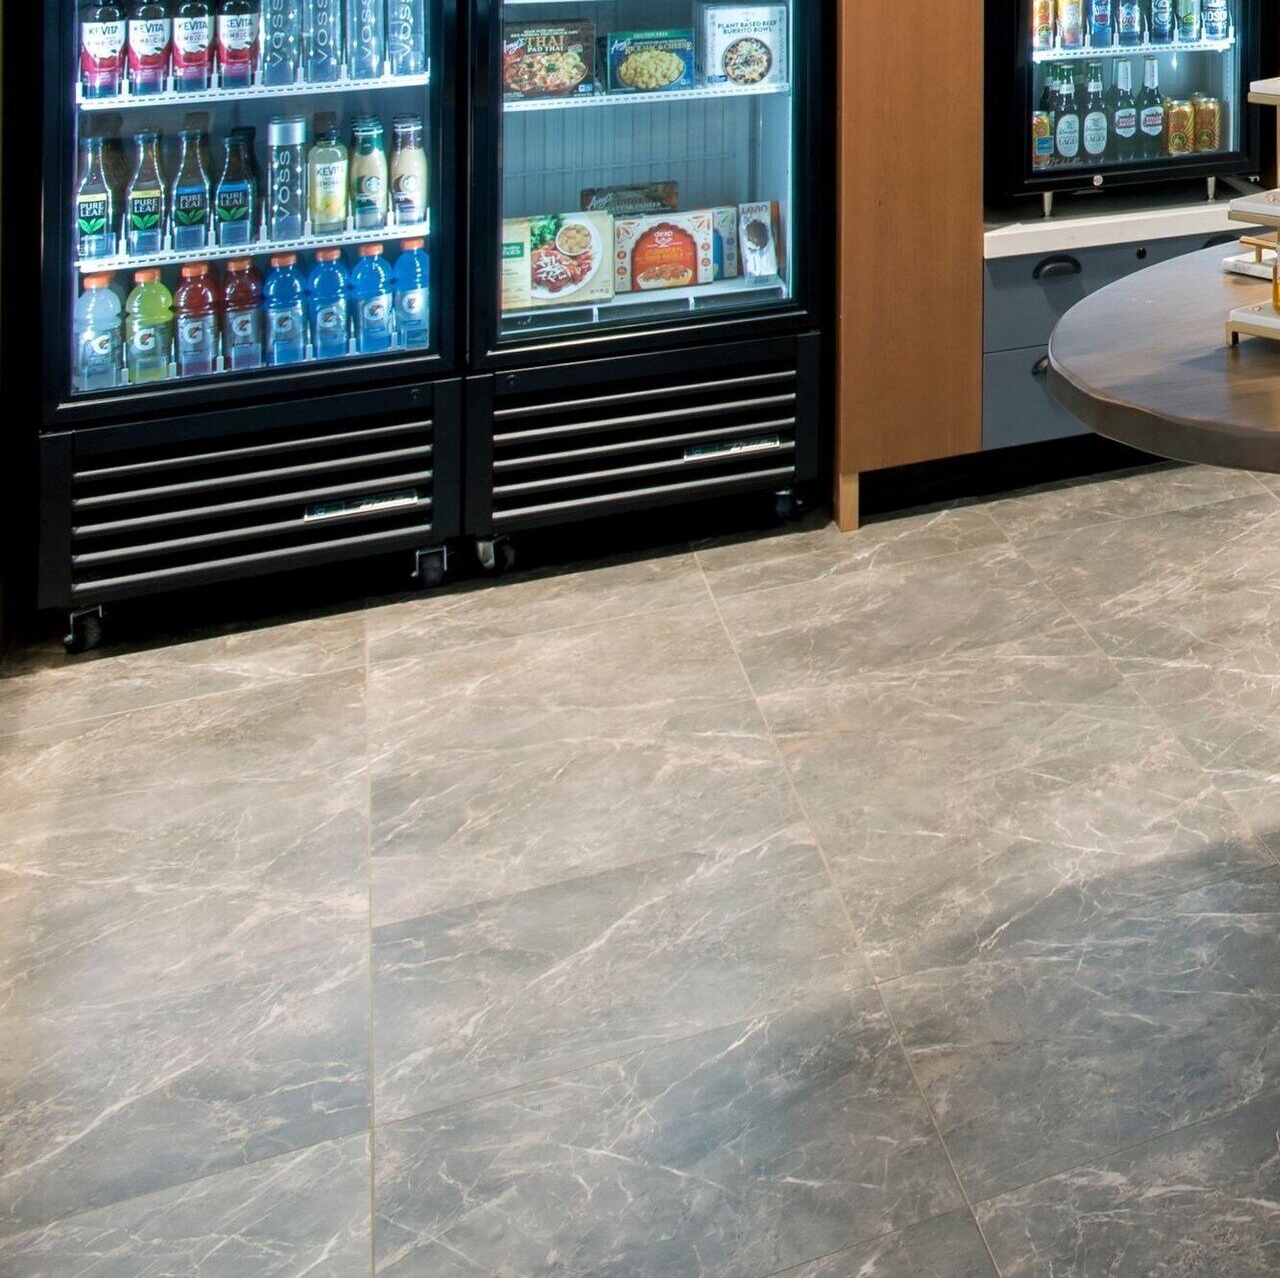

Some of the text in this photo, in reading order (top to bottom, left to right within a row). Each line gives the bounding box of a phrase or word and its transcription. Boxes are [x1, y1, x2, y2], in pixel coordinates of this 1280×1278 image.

[525, 35, 565, 47] THAI
[279, 151, 291, 222] VOSS
[134, 199, 157, 207] PURE
[180, 195, 202, 203] PURE
[80, 202, 104, 210] PURE
